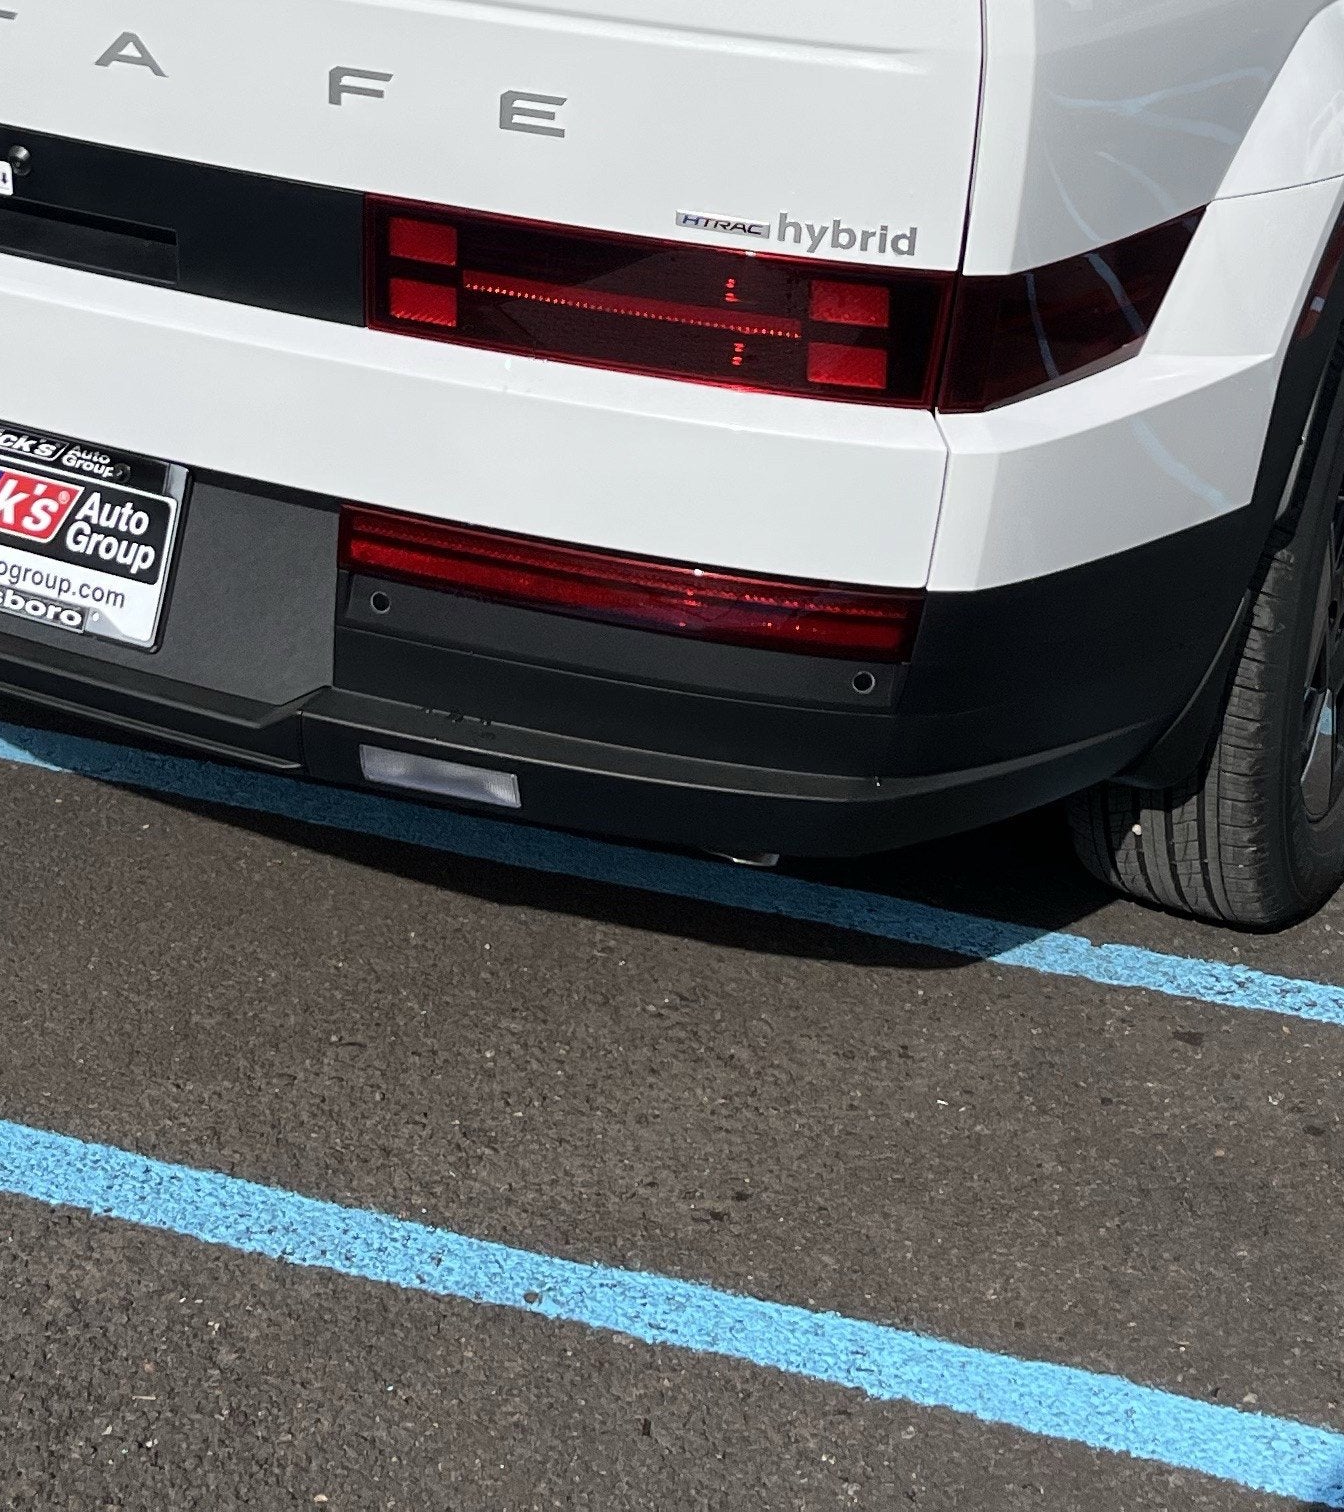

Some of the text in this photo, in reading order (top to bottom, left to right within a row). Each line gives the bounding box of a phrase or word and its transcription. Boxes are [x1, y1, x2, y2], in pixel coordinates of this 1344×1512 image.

[327, 65, 568, 139] FE
[682, 210, 918, 257] HTRAC hybrid
[67, 445, 111, 465] Auto
[75, 491, 150, 536] Auto
[65, 522, 156, 574] Group
